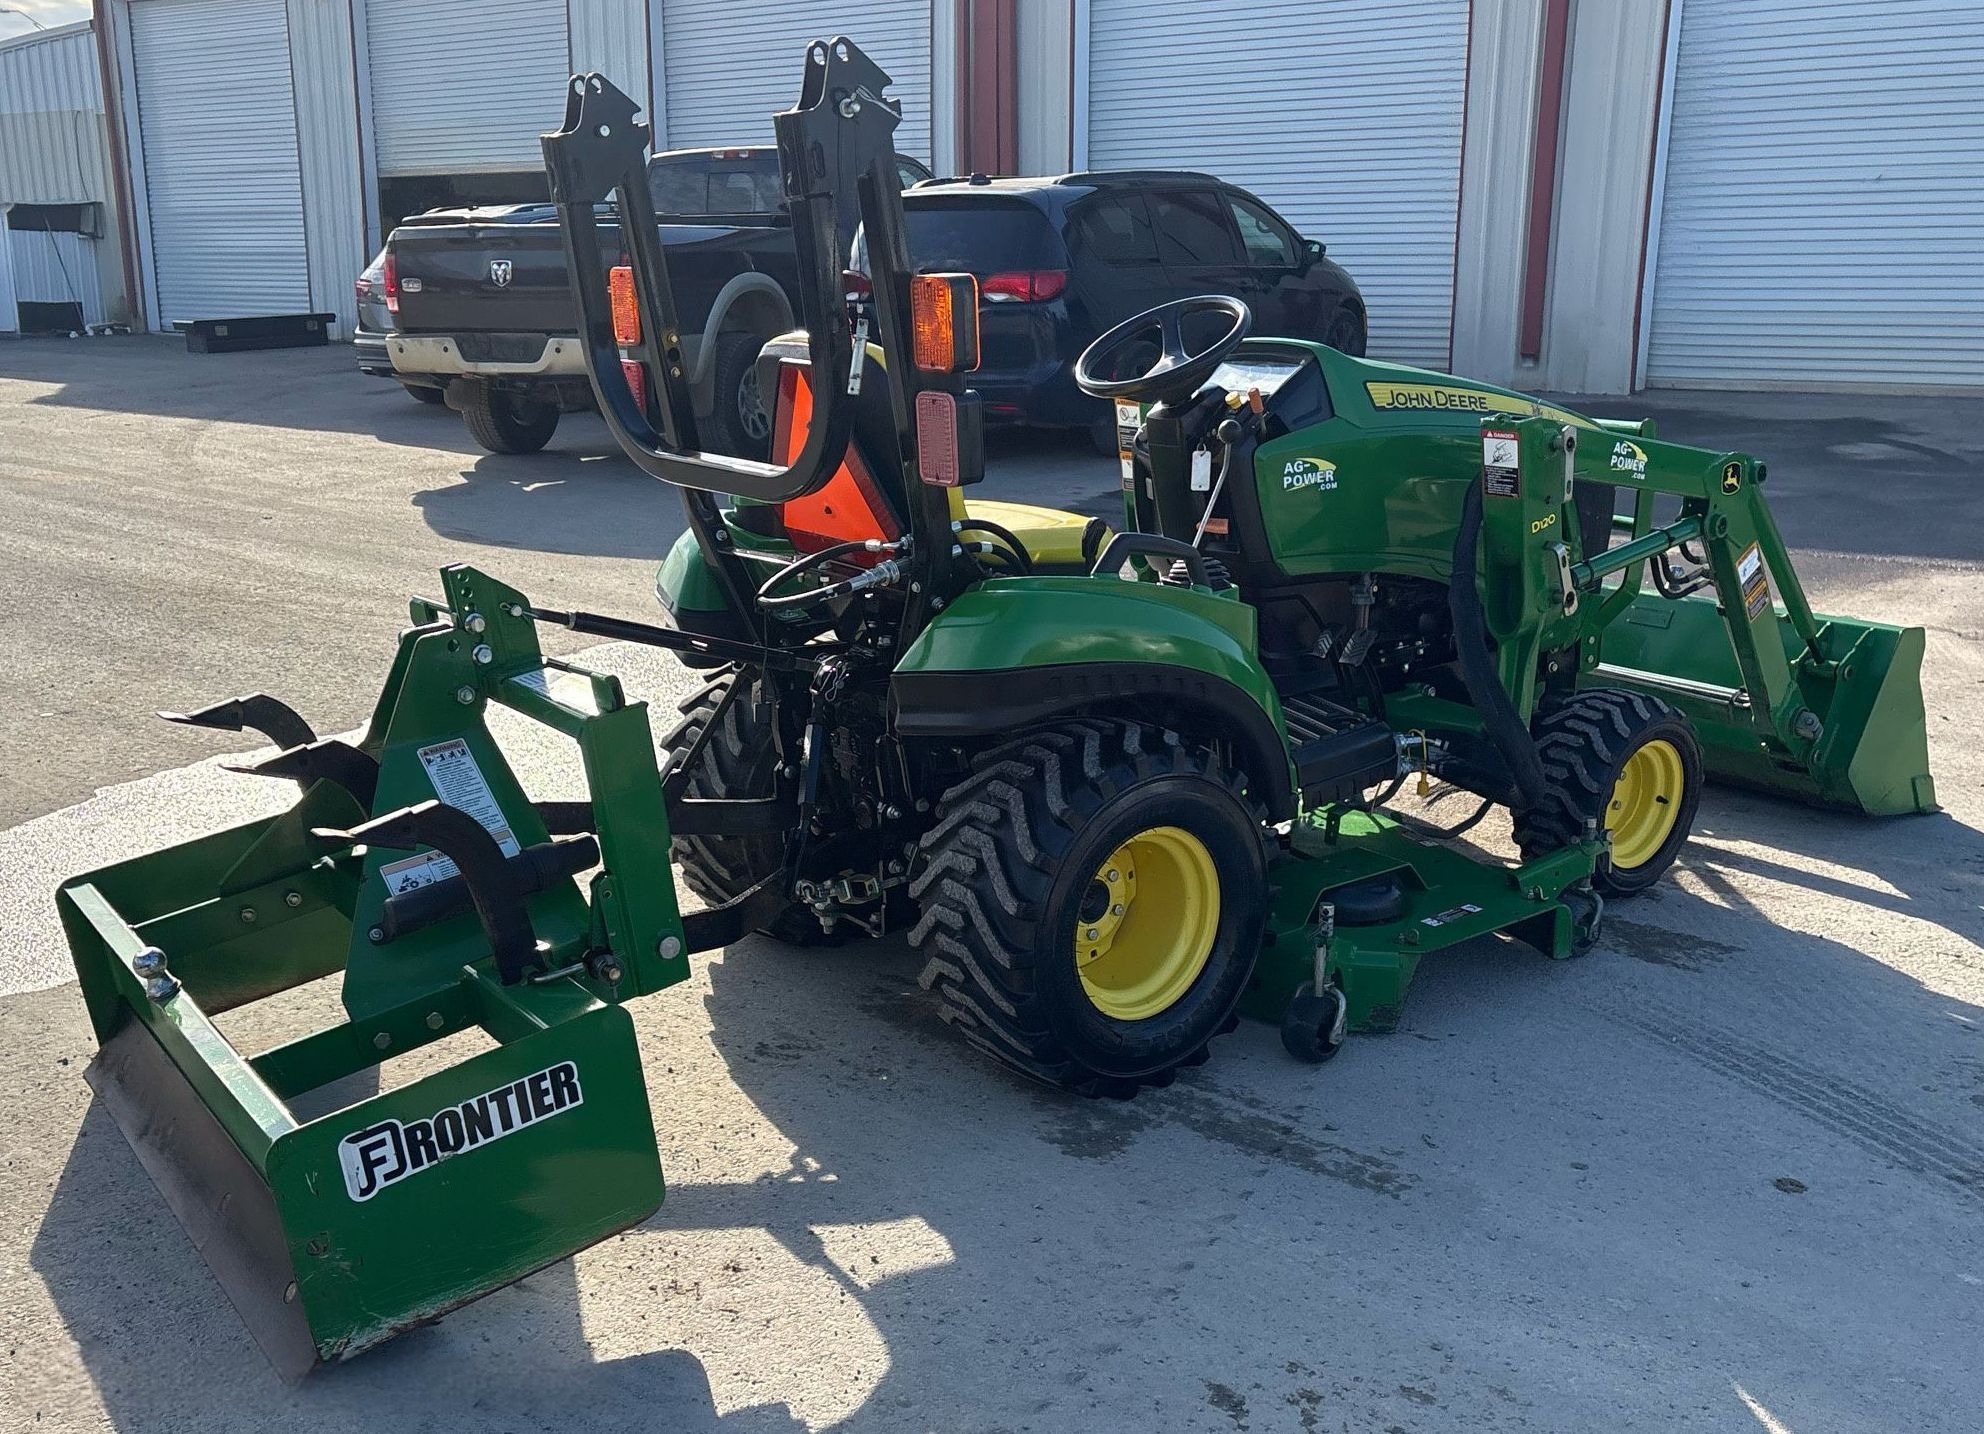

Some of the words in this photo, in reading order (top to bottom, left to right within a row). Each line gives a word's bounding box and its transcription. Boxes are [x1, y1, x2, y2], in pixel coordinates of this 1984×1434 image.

[1386, 390, 1432, 406] JOHN
[1435, 390, 1488, 409] DEERE
[1613, 442, 1632, 455] AG-
[1284, 461, 1310, 474] AG-
[1611, 455, 1645, 473] POWER
[1284, 470, 1335, 489] POWER
[1531, 514, 1556, 533] D120
[345, 1063, 580, 1197] FRONTIER
